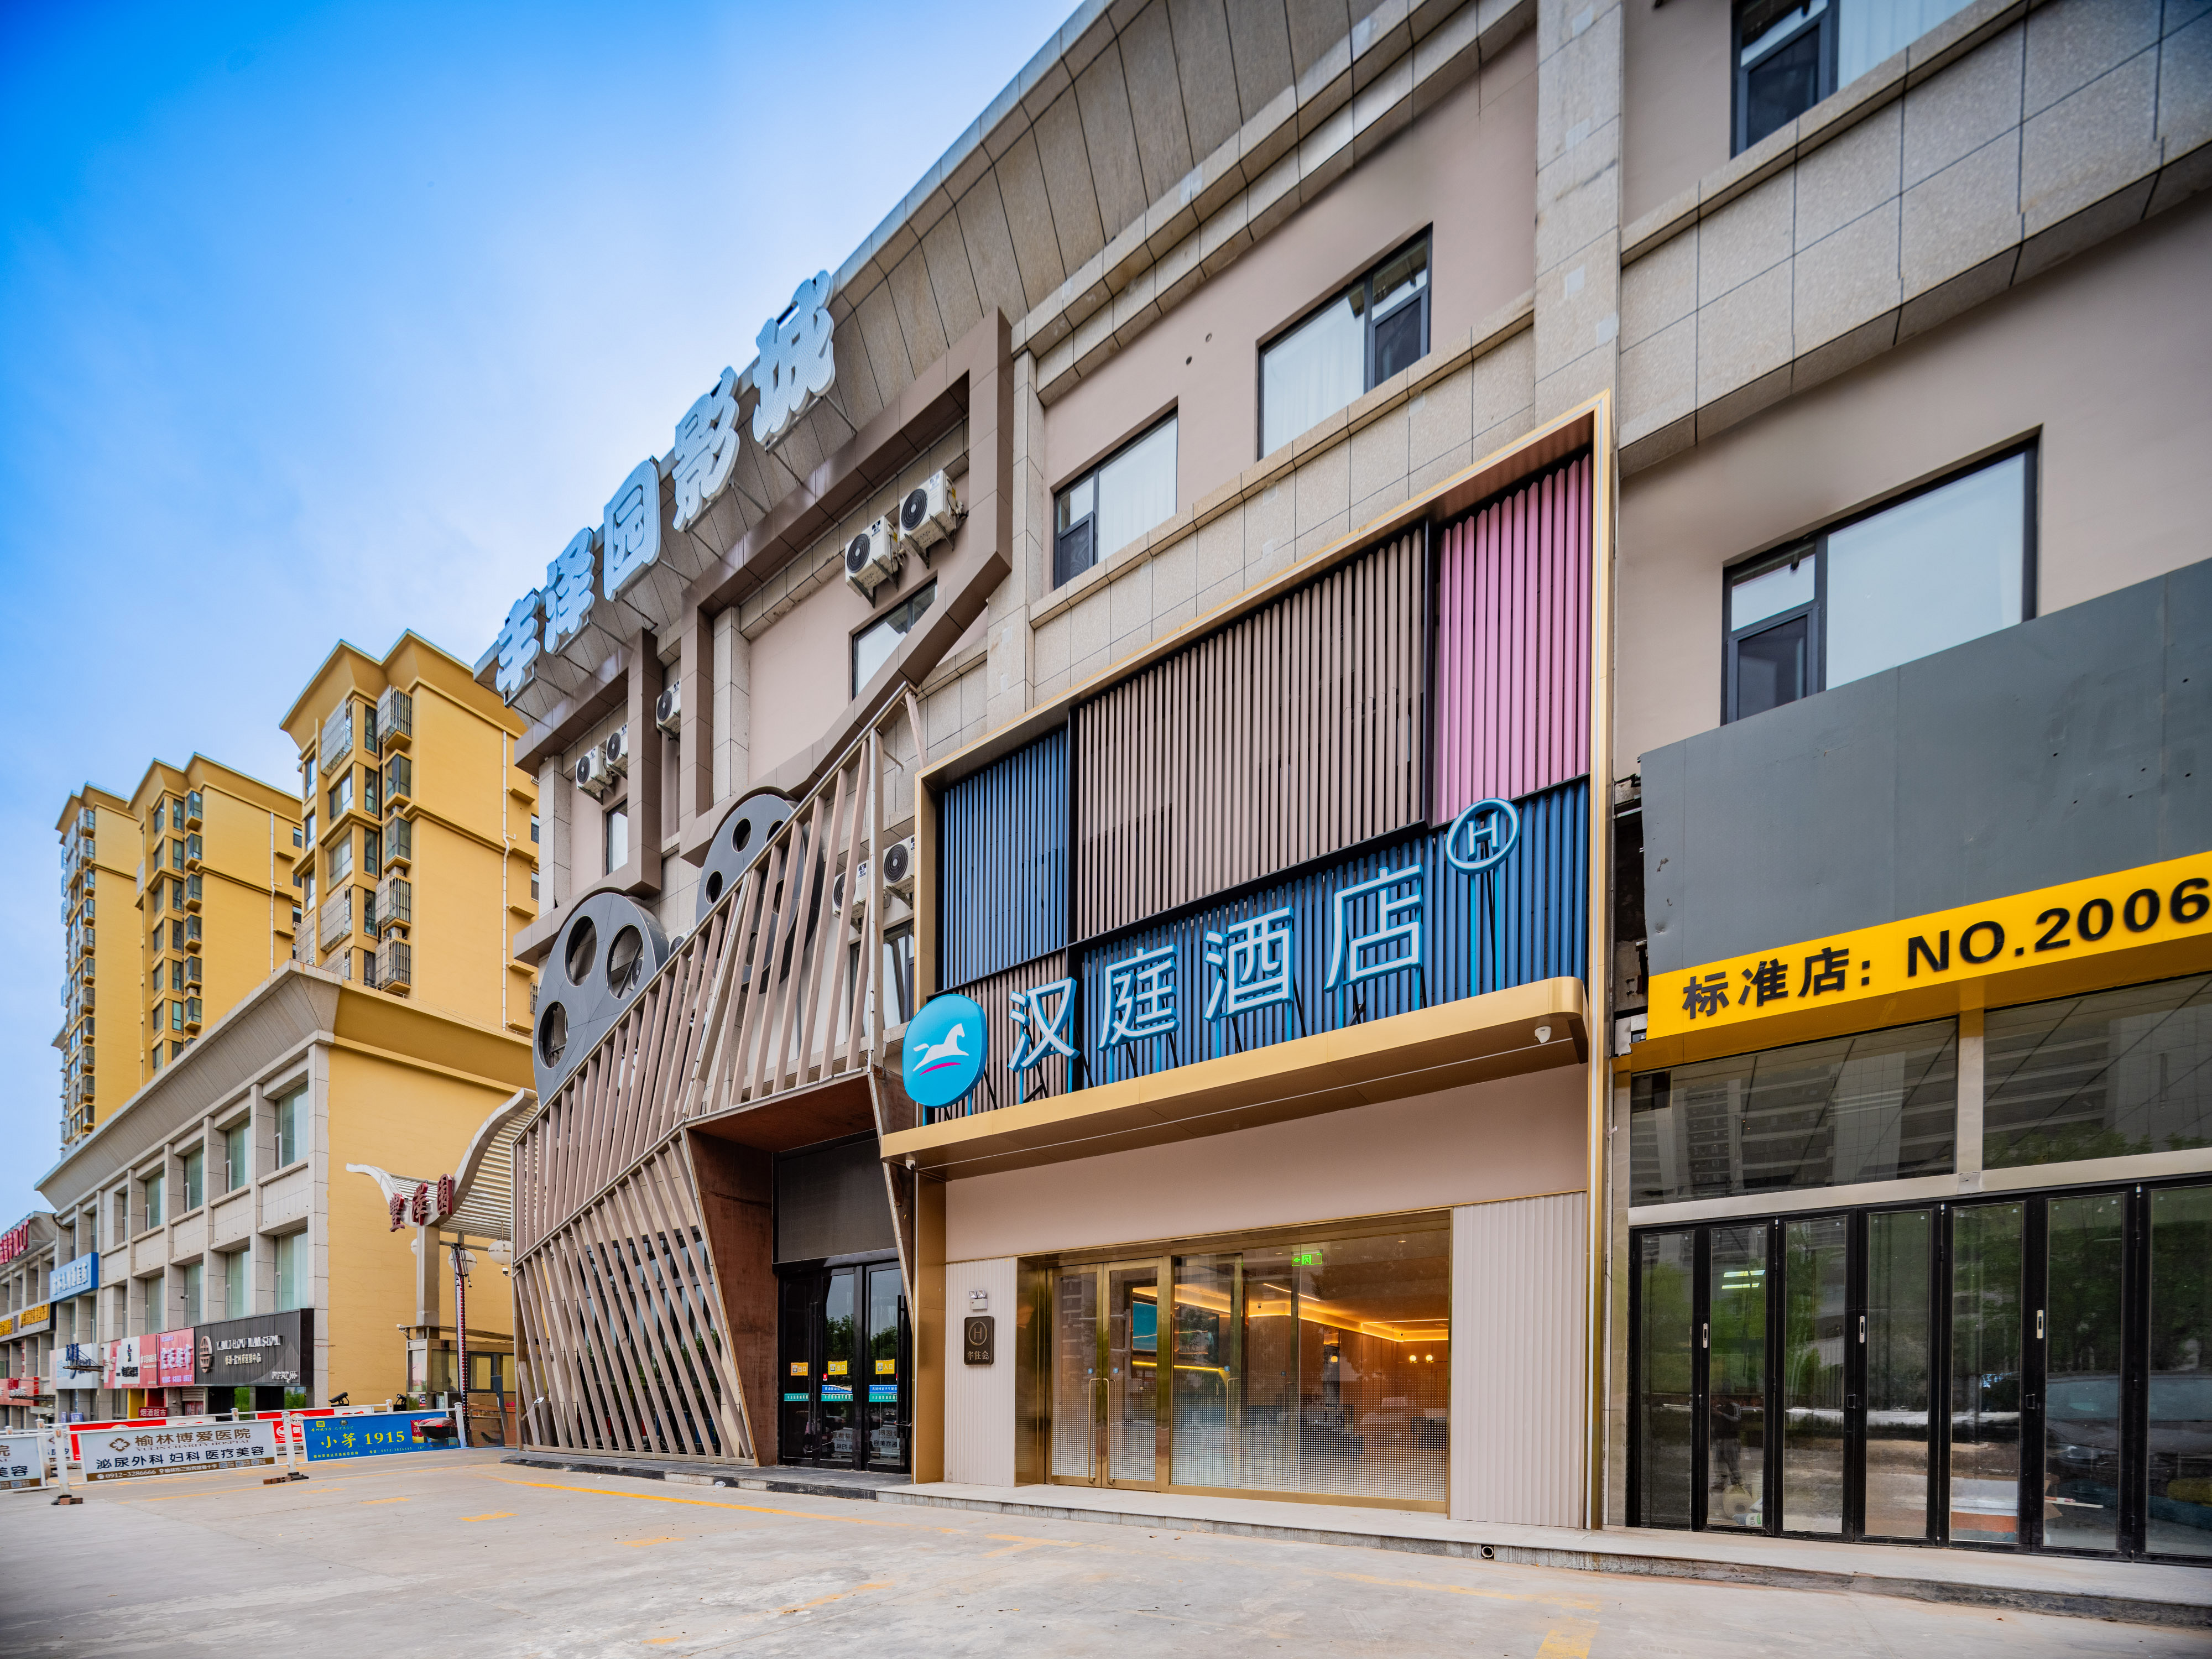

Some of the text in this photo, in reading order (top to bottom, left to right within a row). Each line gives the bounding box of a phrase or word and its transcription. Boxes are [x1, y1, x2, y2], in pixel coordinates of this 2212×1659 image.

[495, 269, 835, 693] 丰泽园影城
[1907, 877, 2210, 978] NO.2006
[1008, 863, 1423, 1072] 汉庭酒店
[967, 1350, 989, 1360] 华住会
[140, 1408, 166, 1417] 烟酒超市
[135, 1428, 251, 1447] 榆林博爱医院
[321, 1431, 405, 1448] 小茅 1915
[96, 1446, 264, 1469] 泌尿外科 妇科 医疗美容
[105, 1469, 156, 1479] 0912-3286666
